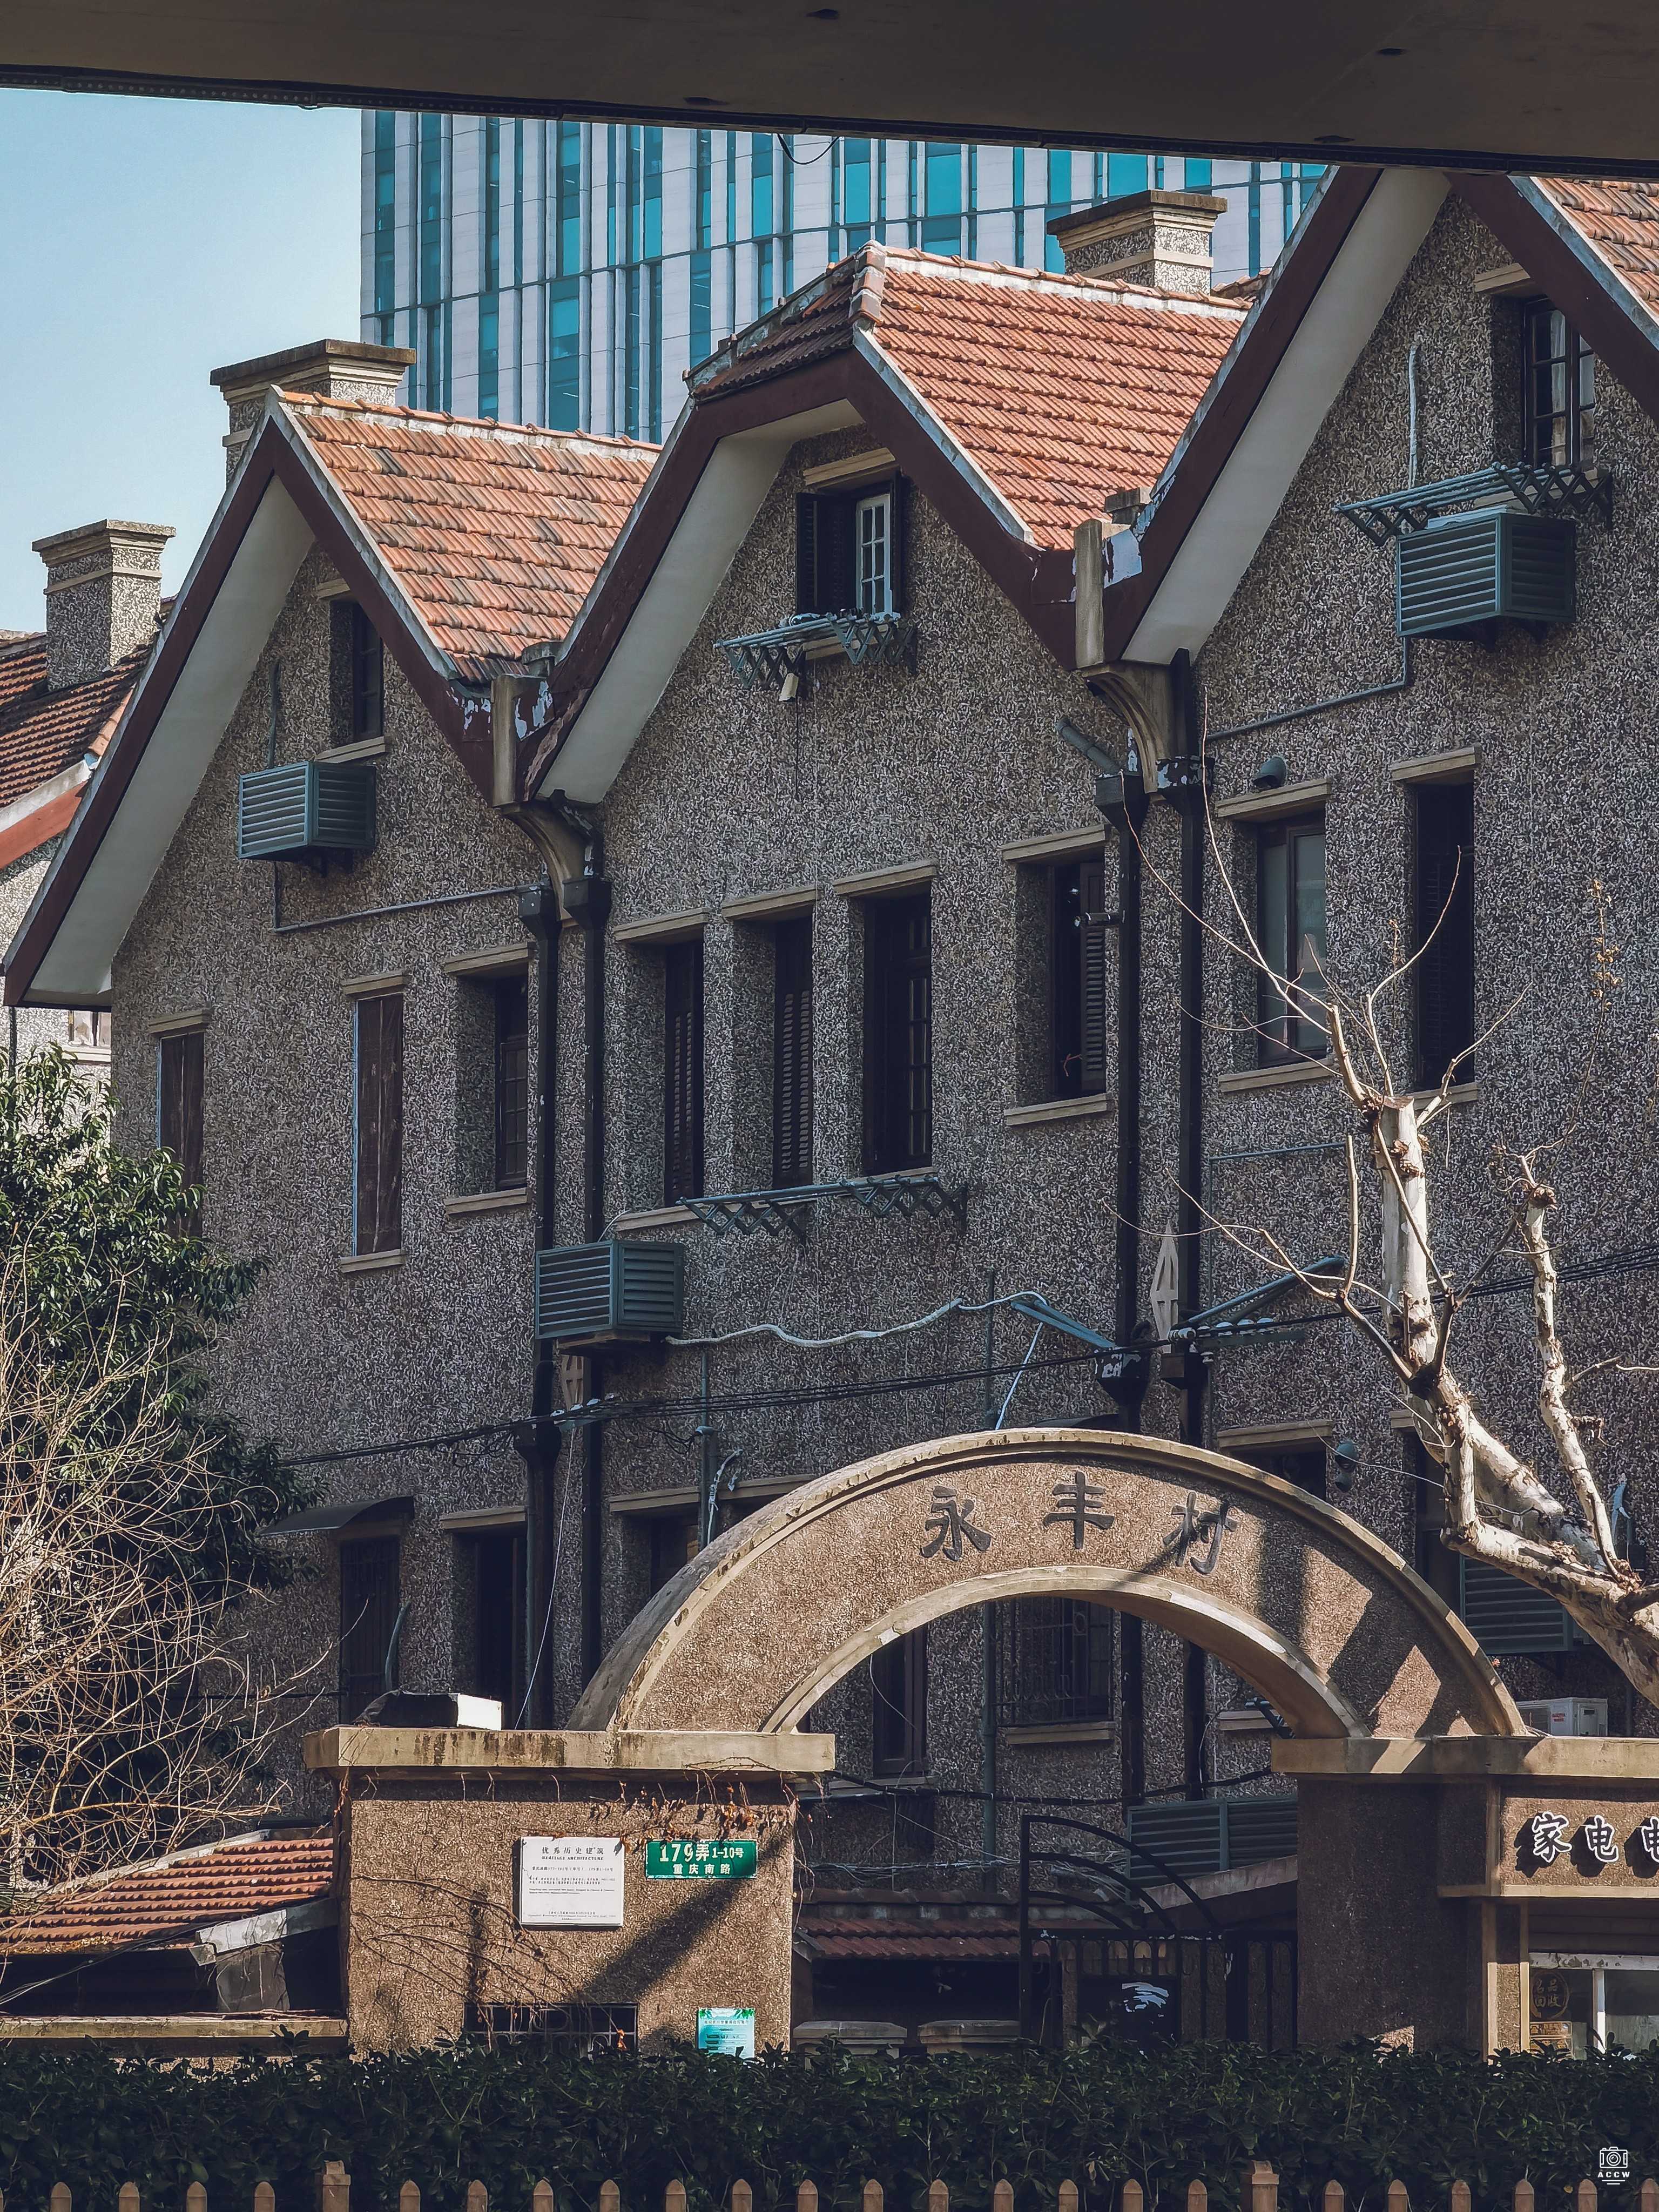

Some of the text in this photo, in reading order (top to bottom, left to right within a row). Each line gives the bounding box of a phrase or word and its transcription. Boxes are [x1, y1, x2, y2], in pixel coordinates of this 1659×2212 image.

[920, 1471, 1237, 1574] 永丰村
[542, 1846, 604, 1854] 优秀历史建筑
[673, 1863, 730, 1875] 重庆南路
